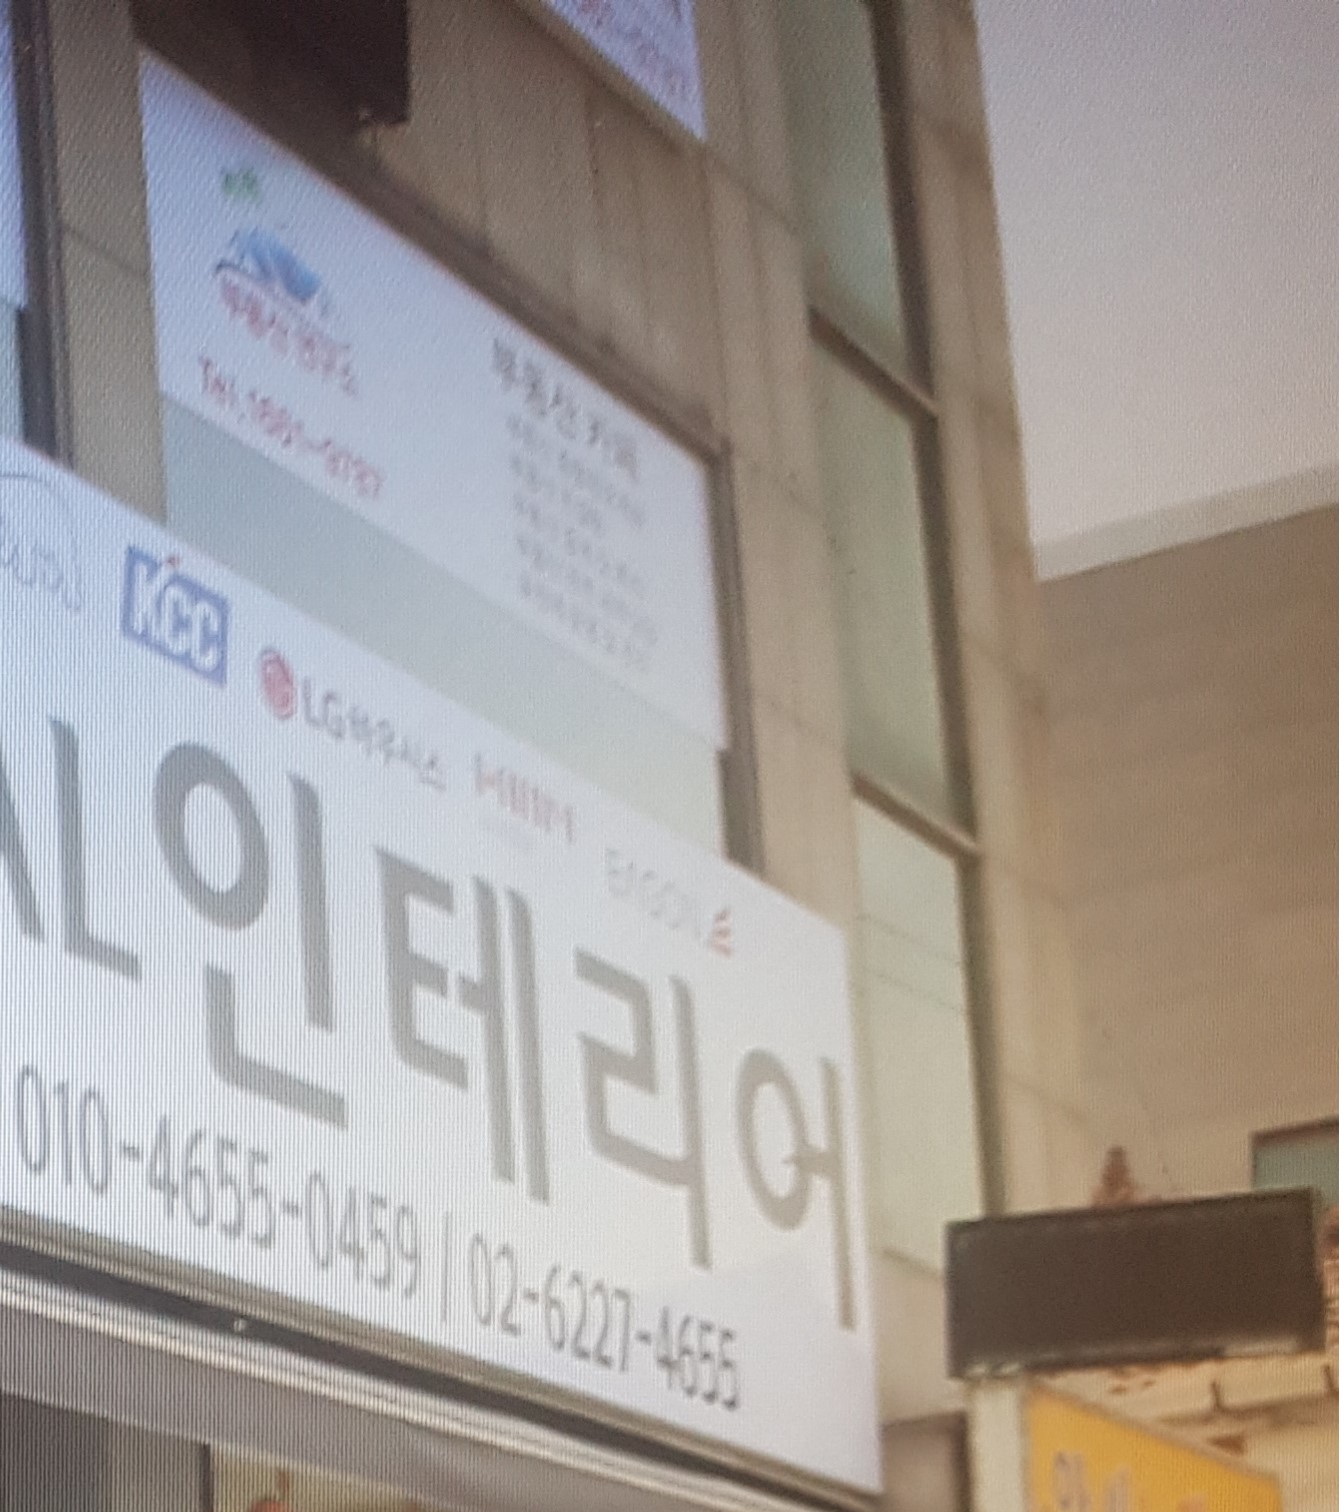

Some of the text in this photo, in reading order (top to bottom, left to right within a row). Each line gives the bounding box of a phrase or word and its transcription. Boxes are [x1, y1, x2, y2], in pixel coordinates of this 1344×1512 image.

[130, 555, 224, 677] KCC
[152, 741, 856, 1331] 인테리어
[15, 1062, 423, 1302] 010-4655-0459
[468, 1231, 742, 1411] 02-6227-4655
